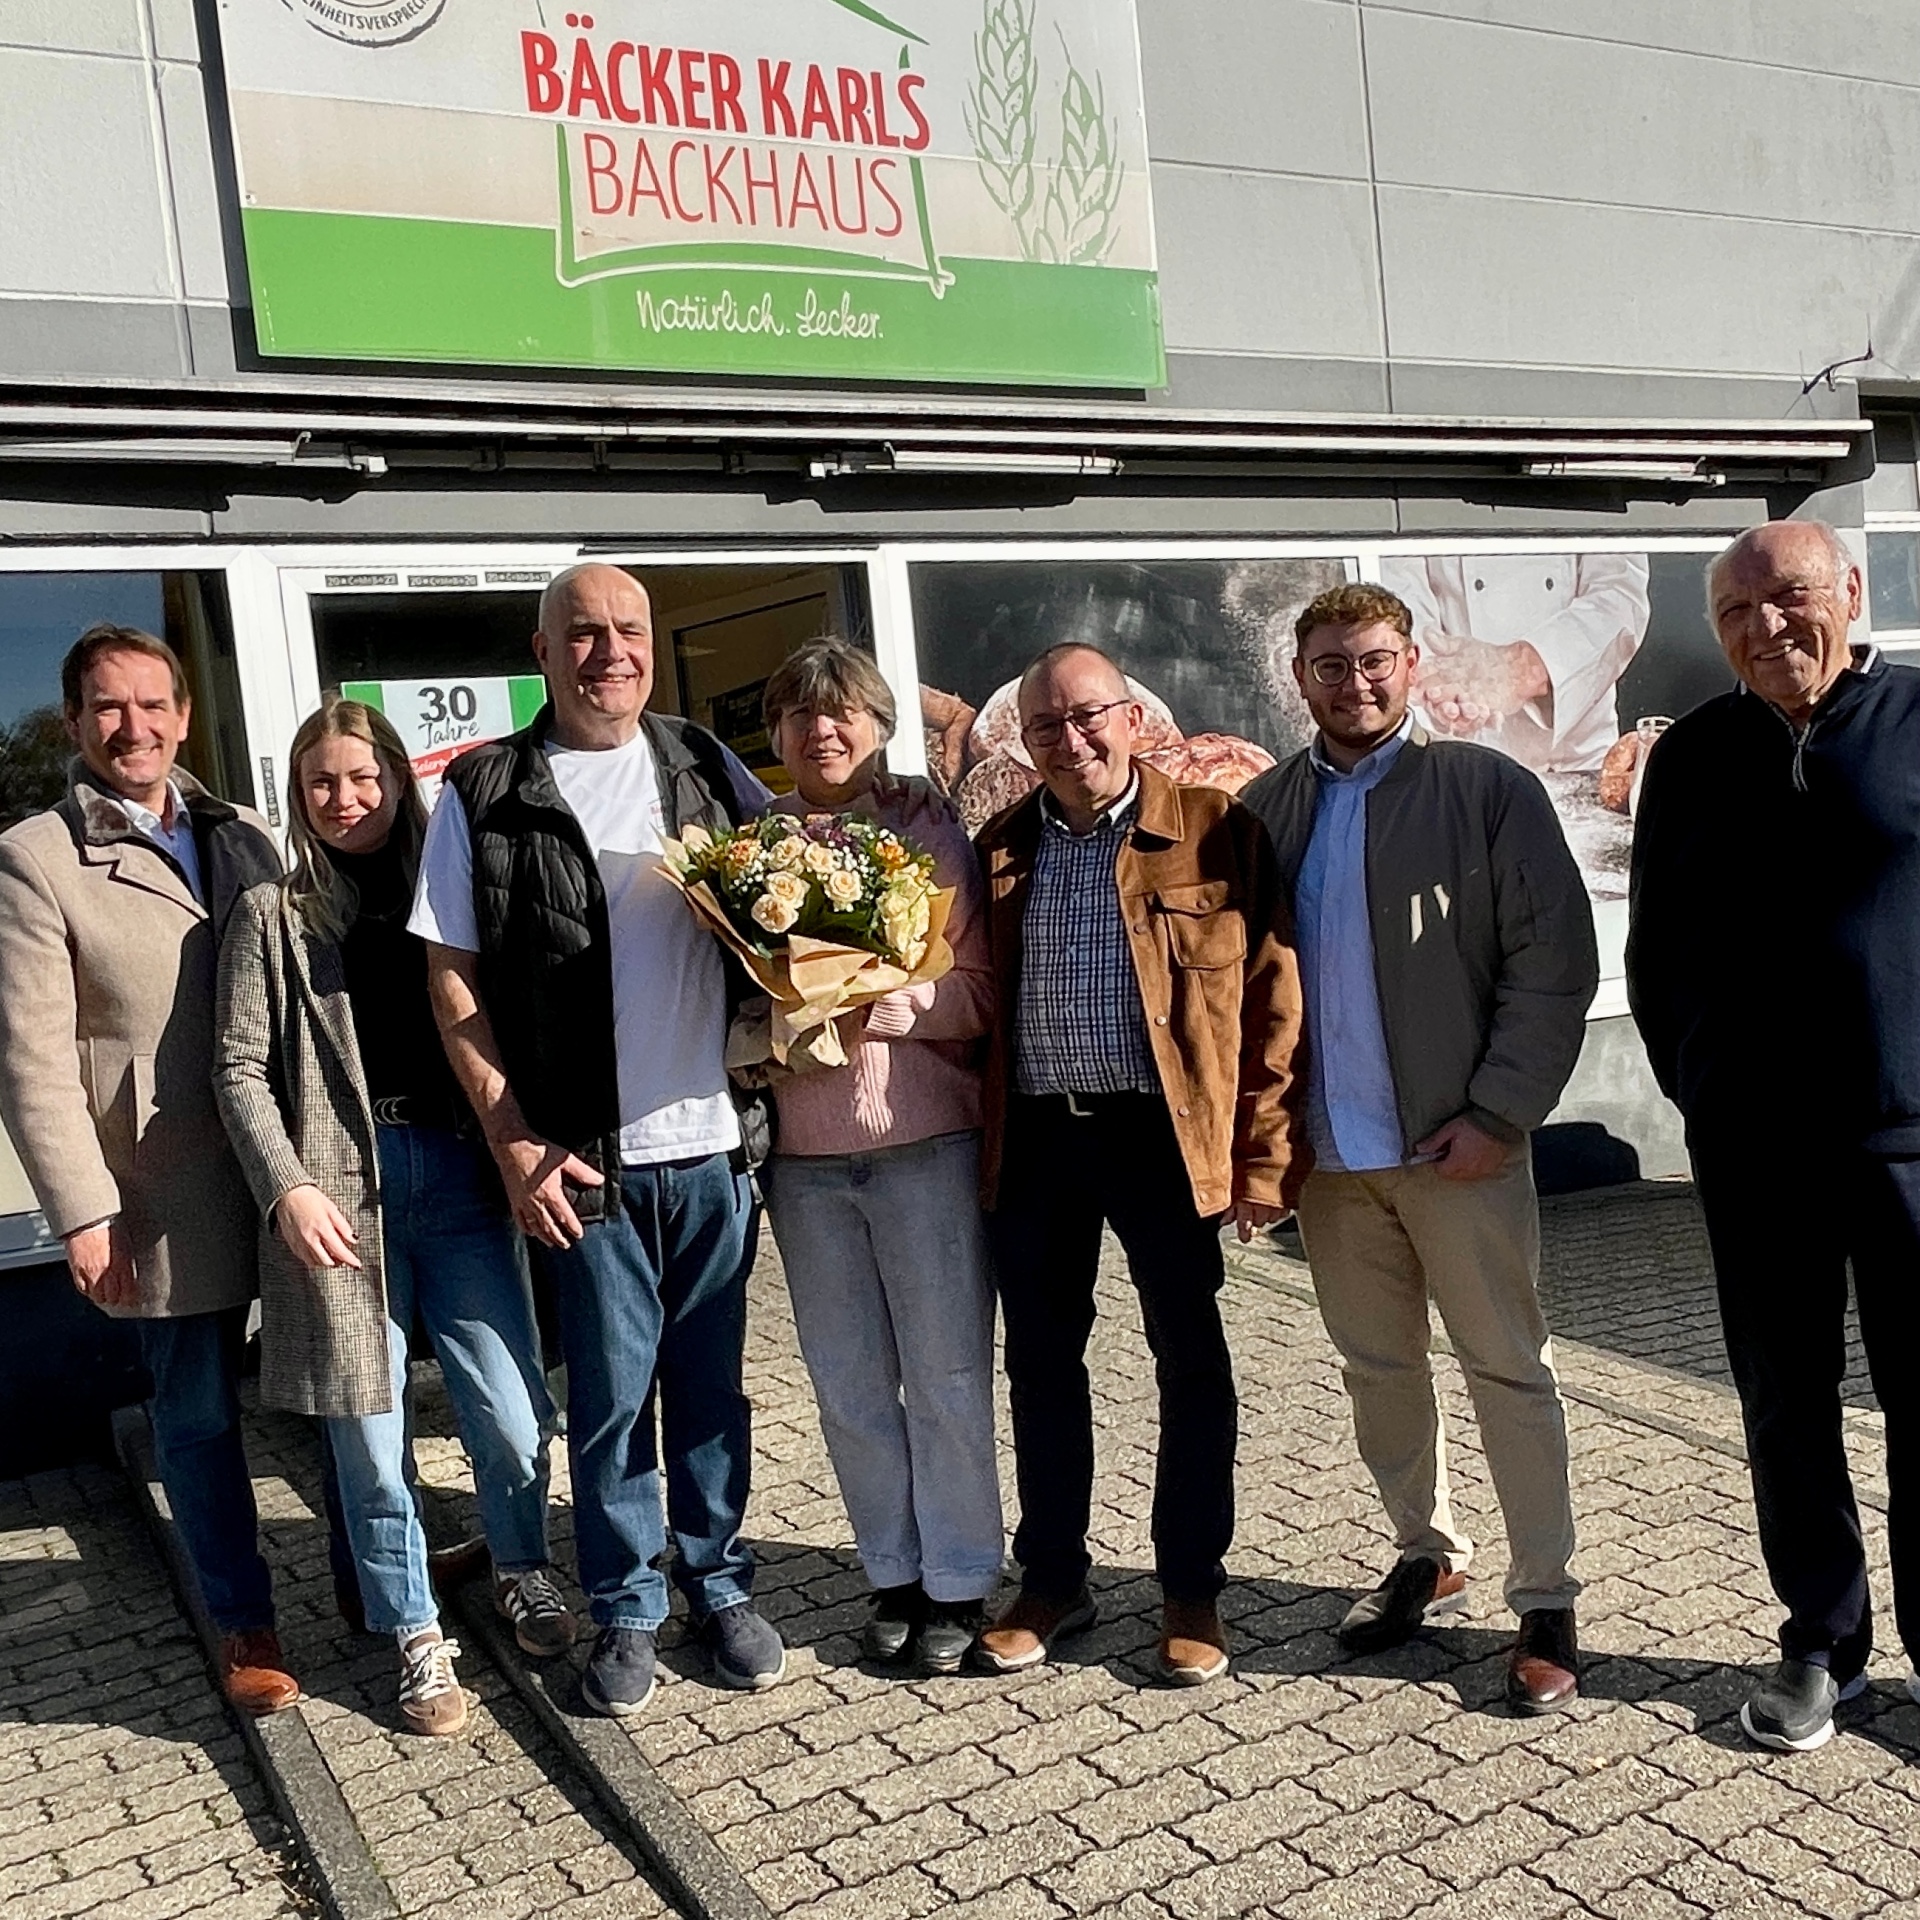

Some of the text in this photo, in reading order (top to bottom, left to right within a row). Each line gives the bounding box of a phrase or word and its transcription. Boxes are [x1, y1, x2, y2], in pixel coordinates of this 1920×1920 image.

[521, 13, 747, 133] BÄCKER
[583, 132, 903, 237] BACKHAUS
[636, 288, 884, 339] Natürlich. Lecker.
[418, 685, 477, 723] 30
[418, 716, 480, 749] Jahre
